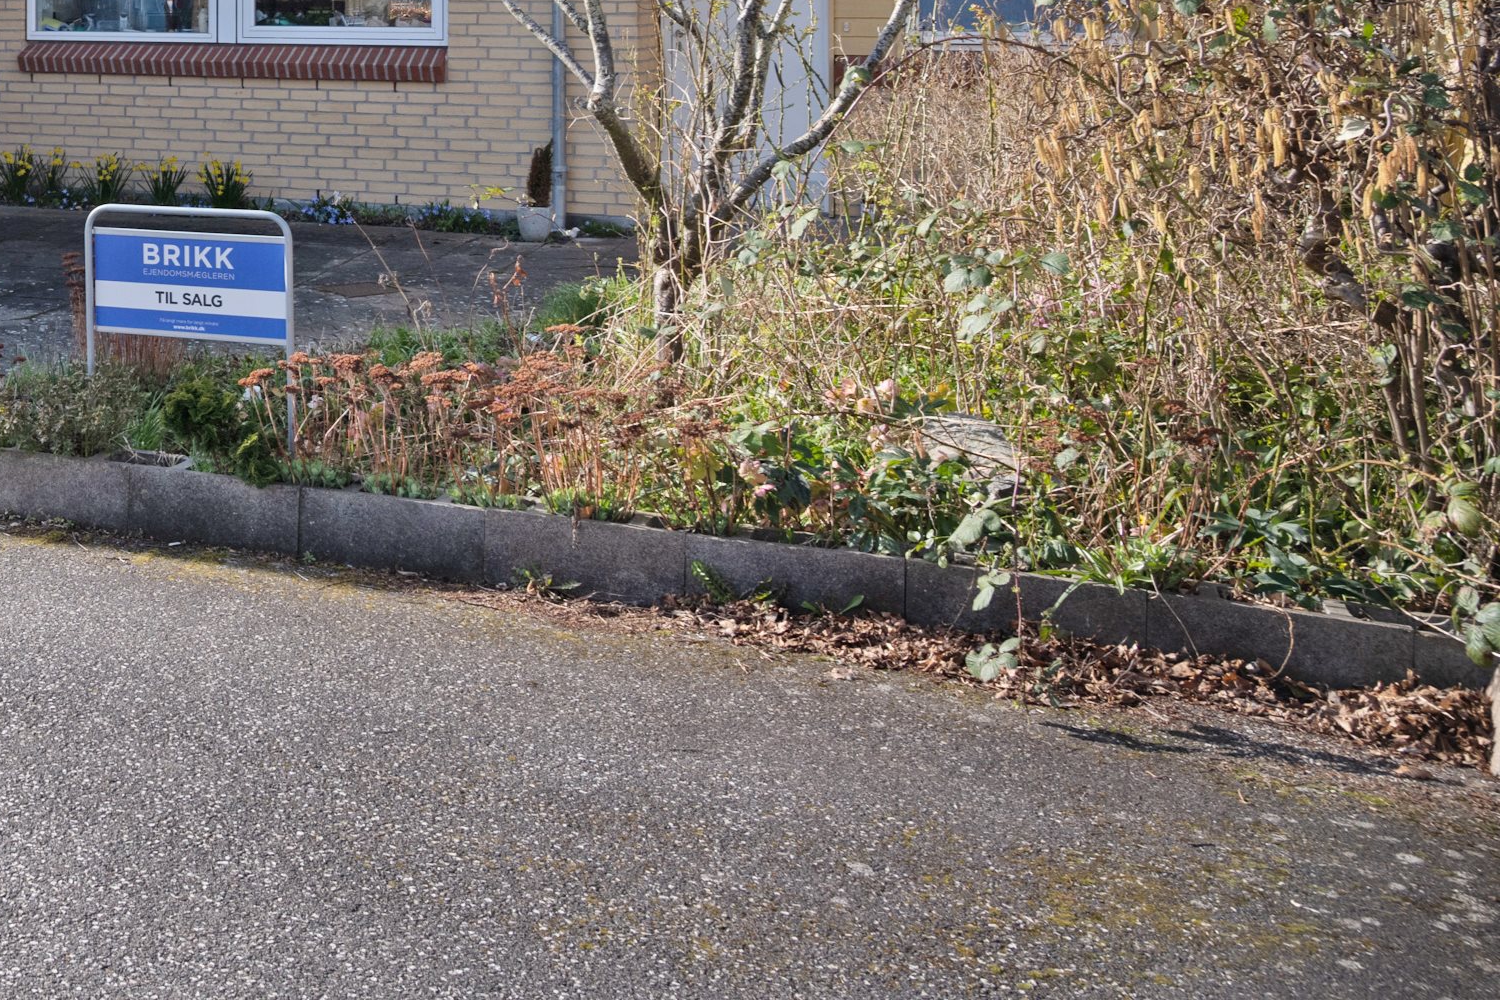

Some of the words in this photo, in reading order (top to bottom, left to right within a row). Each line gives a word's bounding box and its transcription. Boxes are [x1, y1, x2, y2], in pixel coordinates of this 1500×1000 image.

[142, 242, 235, 270] BRIKK
[142, 267, 236, 281] EJENDOMSMÆGLEREN
[155, 290, 178, 305] TIL
[182, 292, 223, 308] SALG
